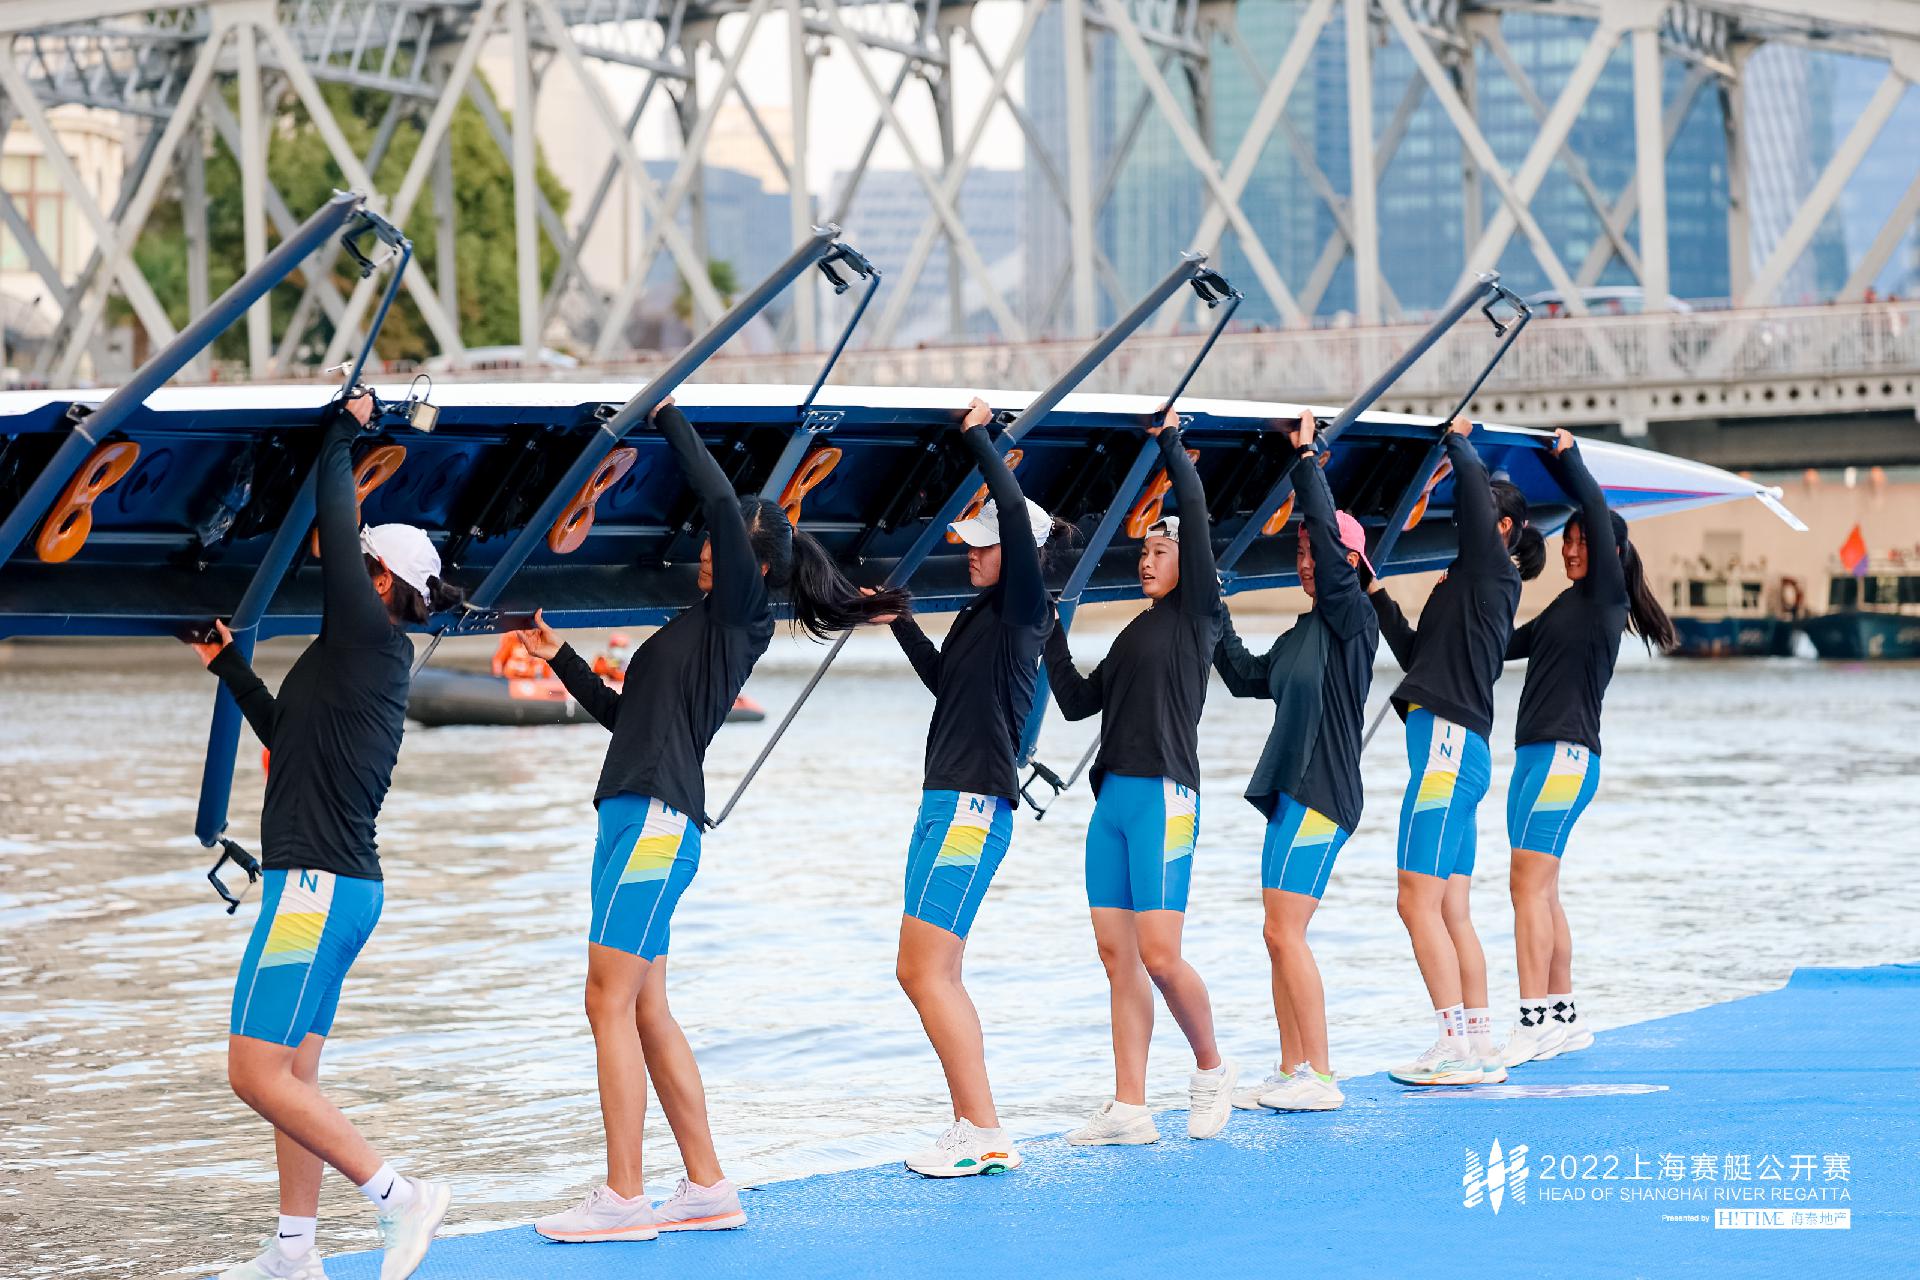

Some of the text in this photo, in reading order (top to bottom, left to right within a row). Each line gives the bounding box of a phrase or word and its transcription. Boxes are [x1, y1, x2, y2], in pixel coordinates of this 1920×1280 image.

[1567, 742, 1580, 760] N
[969, 797, 985, 814] N
[299, 868, 319, 893] N
